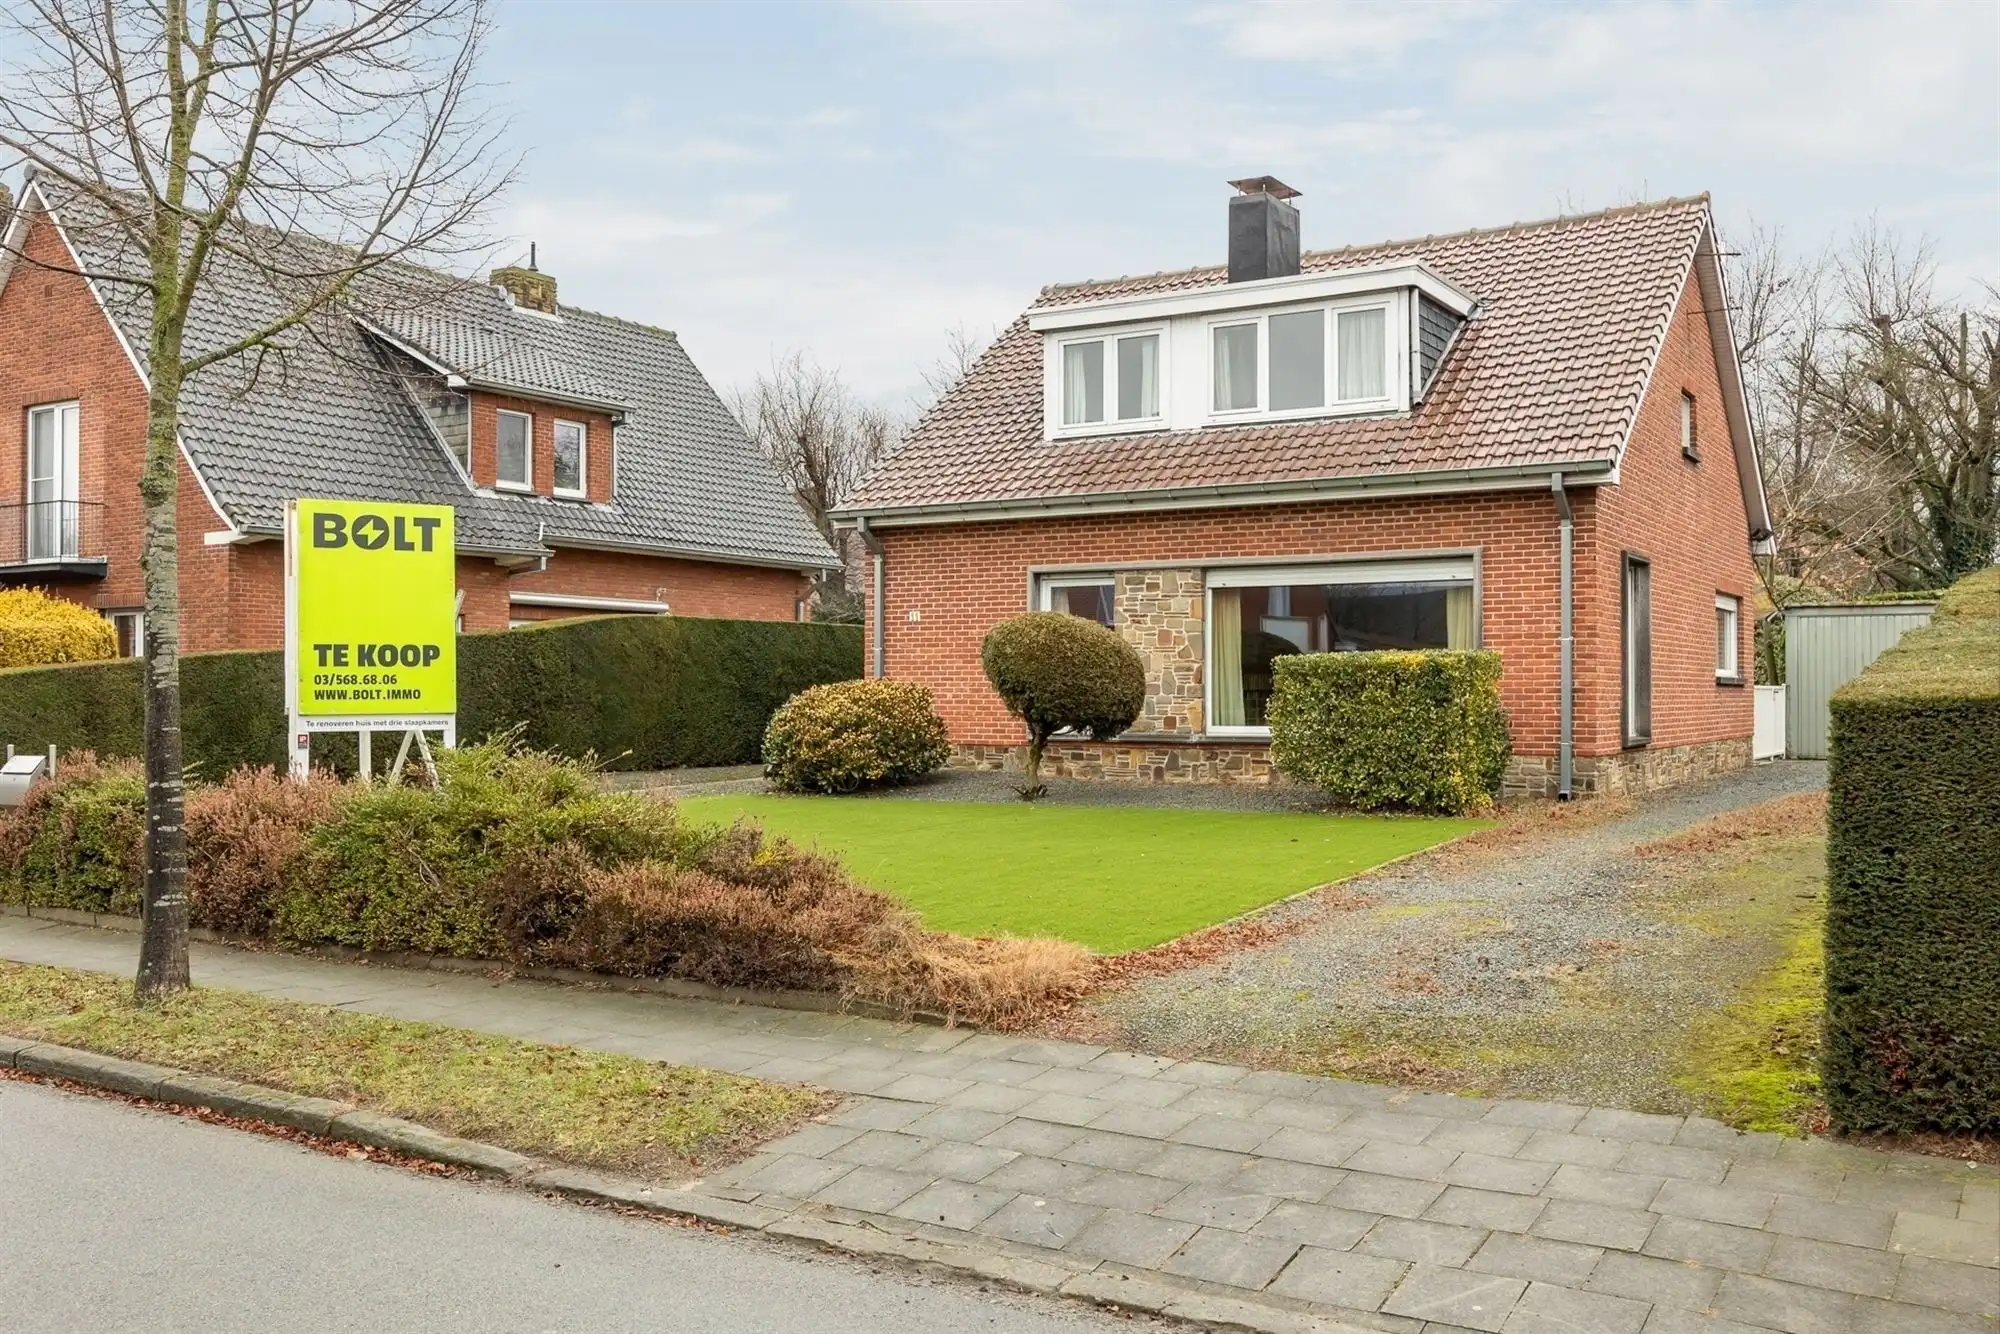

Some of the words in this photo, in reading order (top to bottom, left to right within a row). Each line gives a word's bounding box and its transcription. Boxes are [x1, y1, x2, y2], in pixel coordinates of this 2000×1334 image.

[313, 512, 441, 552] BOLT
[313, 644, 349, 667] TE
[357, 644, 440, 667] KOOP
[314, 674, 397, 685] 03/568.68.06
[314, 689, 421, 700] WWW.BOLT.IMMO
[404, 719, 449, 727] slaapkamers
